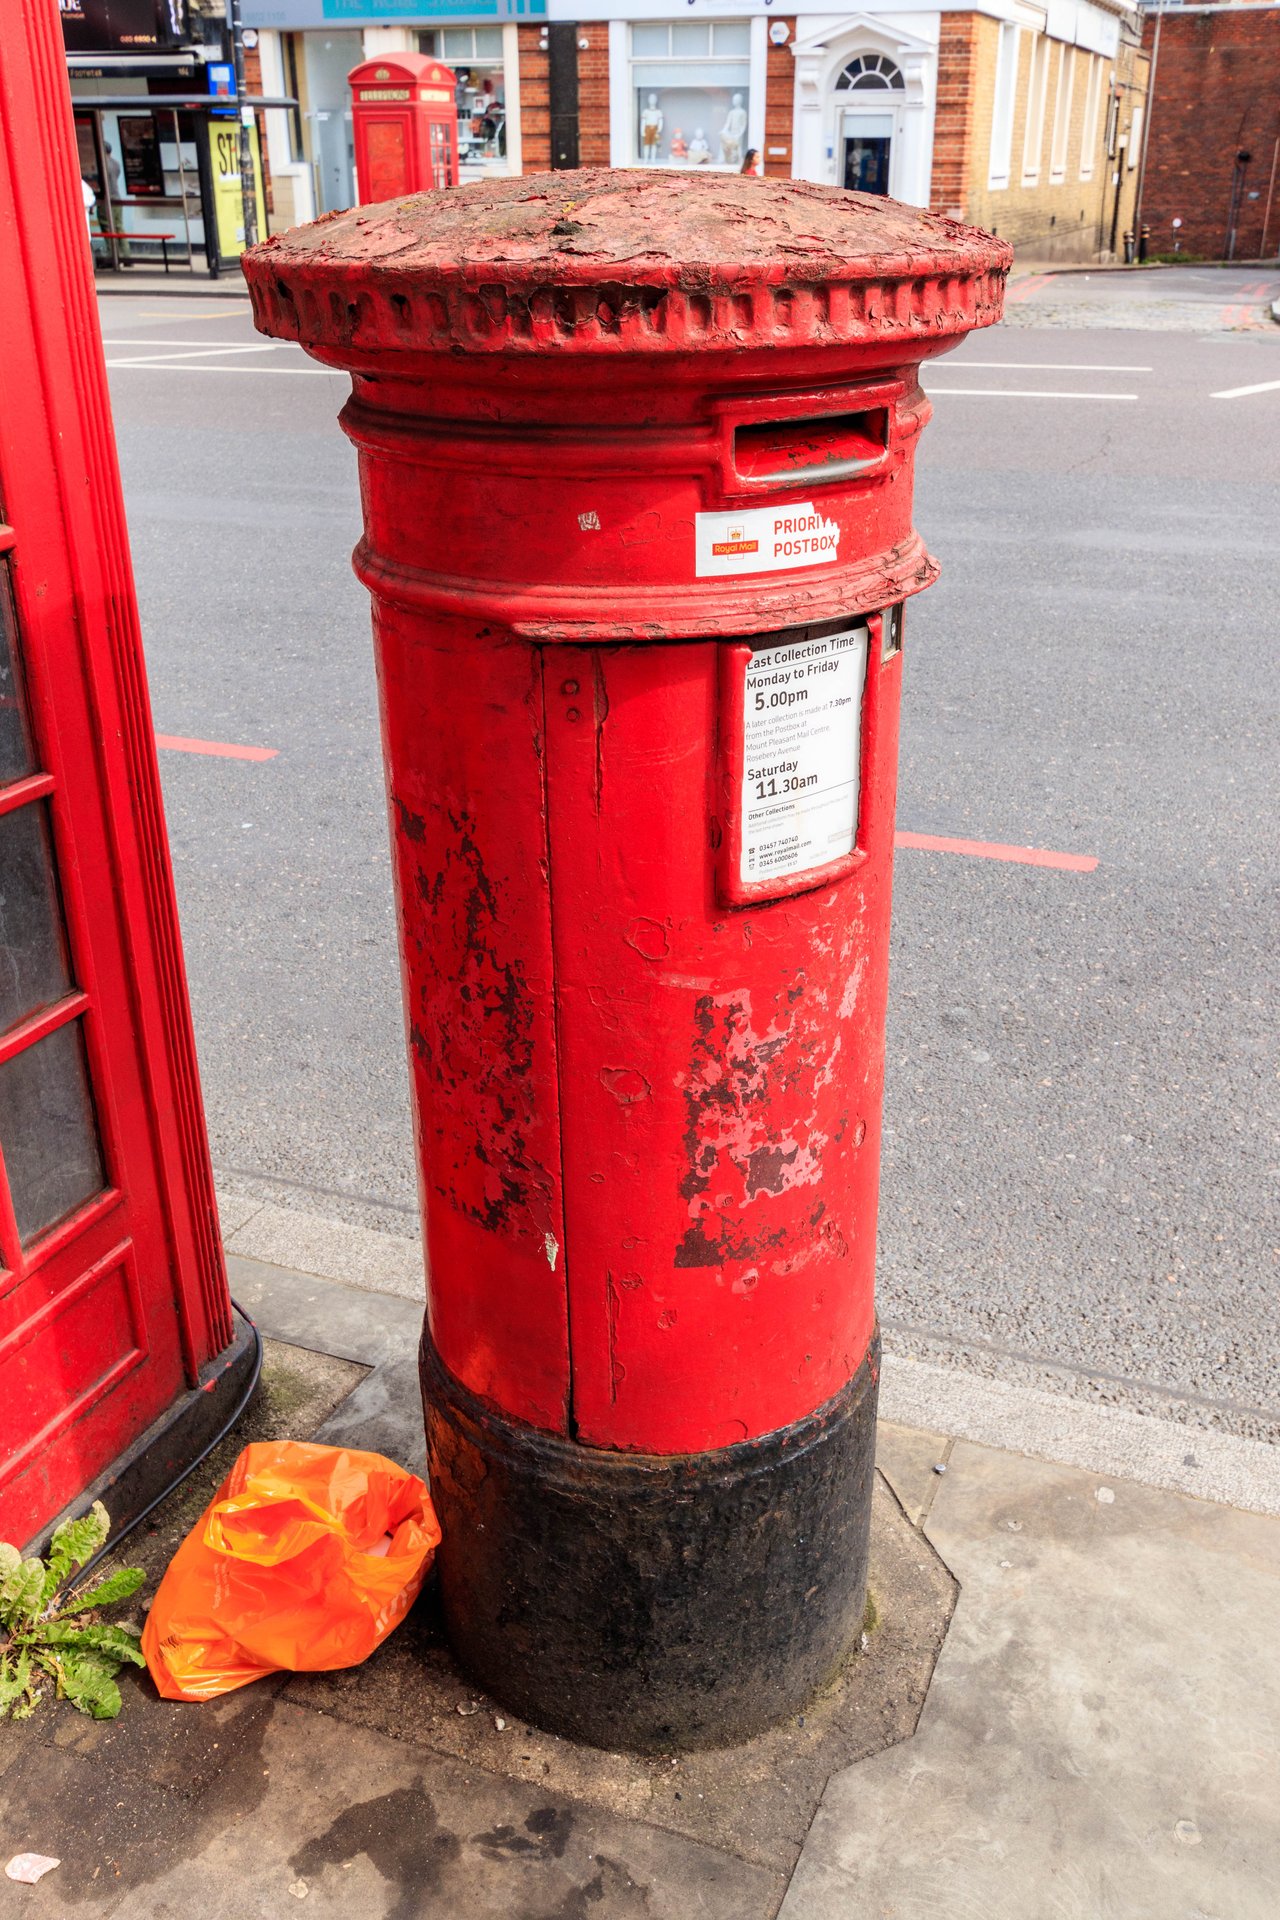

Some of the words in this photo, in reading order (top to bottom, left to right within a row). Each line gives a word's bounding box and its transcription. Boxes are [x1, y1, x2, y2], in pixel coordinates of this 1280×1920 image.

[774, 516, 834, 535] PRIORI
[715, 544, 738, 554] Royal
[739, 541, 756, 551] Mail
[774, 535, 836, 557] POSTBOX
[747, 655, 771, 670] Last
[774, 644, 827, 664] Collection
[829, 637, 855, 651] Time
[746, 672, 791, 690] Monday
[794, 669, 805, 679] to
[807, 660, 840, 677] Friday
[755, 689, 808, 711] 5.00pm
[745, 721, 751, 730] A
[752, 719, 767, 729] later
[768, 712, 798, 725] collection
[798, 710, 804, 718] is
[804, 705, 821, 715] made
[822, 703, 829, 711] at
[829, 697, 852, 709] 7.30pm
[745, 731, 763, 741] from
[763, 728, 774, 737] the
[775, 723, 800, 734] Postbox
[800, 720, 807, 728] at
[745, 742, 768, 752] Mount
[768, 734, 797, 747] Pleasant
[797, 729, 810, 739] Mail
[746, 750, 777, 763] Rosebery
[777, 745, 801, 756] Avenue
[747, 761, 799, 781] Saturday
[755, 774, 818, 800] 11.30am
[748, 811, 764, 821] Other
[765, 804, 795, 816] Collections
[759, 841, 777, 851] 03457
[778, 835, 799, 846] 740740
[759, 840, 812, 859] www.royalmail.com
[758, 859, 774, 868] 0345
[774, 852, 799, 864] 6000606
